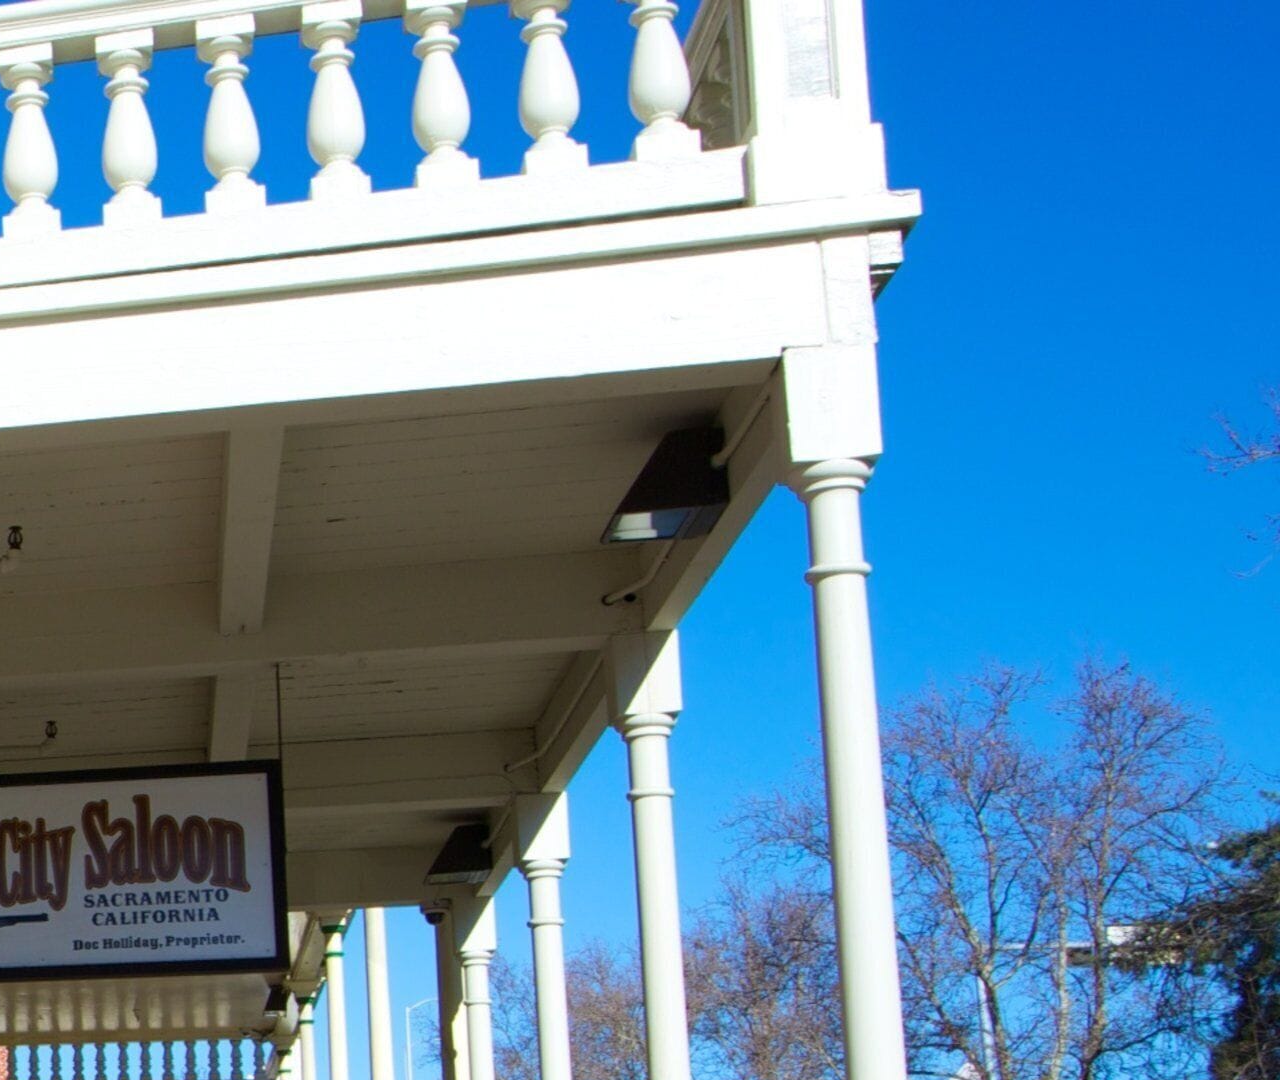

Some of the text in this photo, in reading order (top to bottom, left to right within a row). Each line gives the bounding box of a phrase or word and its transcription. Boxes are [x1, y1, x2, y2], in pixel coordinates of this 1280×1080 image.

[81, 794, 251, 892] Saloon
[83, 888, 229, 908] SACRAMENTO
[92, 908, 220, 926] CALIFORNIA
[73, 933, 245, 951] Doc Holliday, Proprietor.
